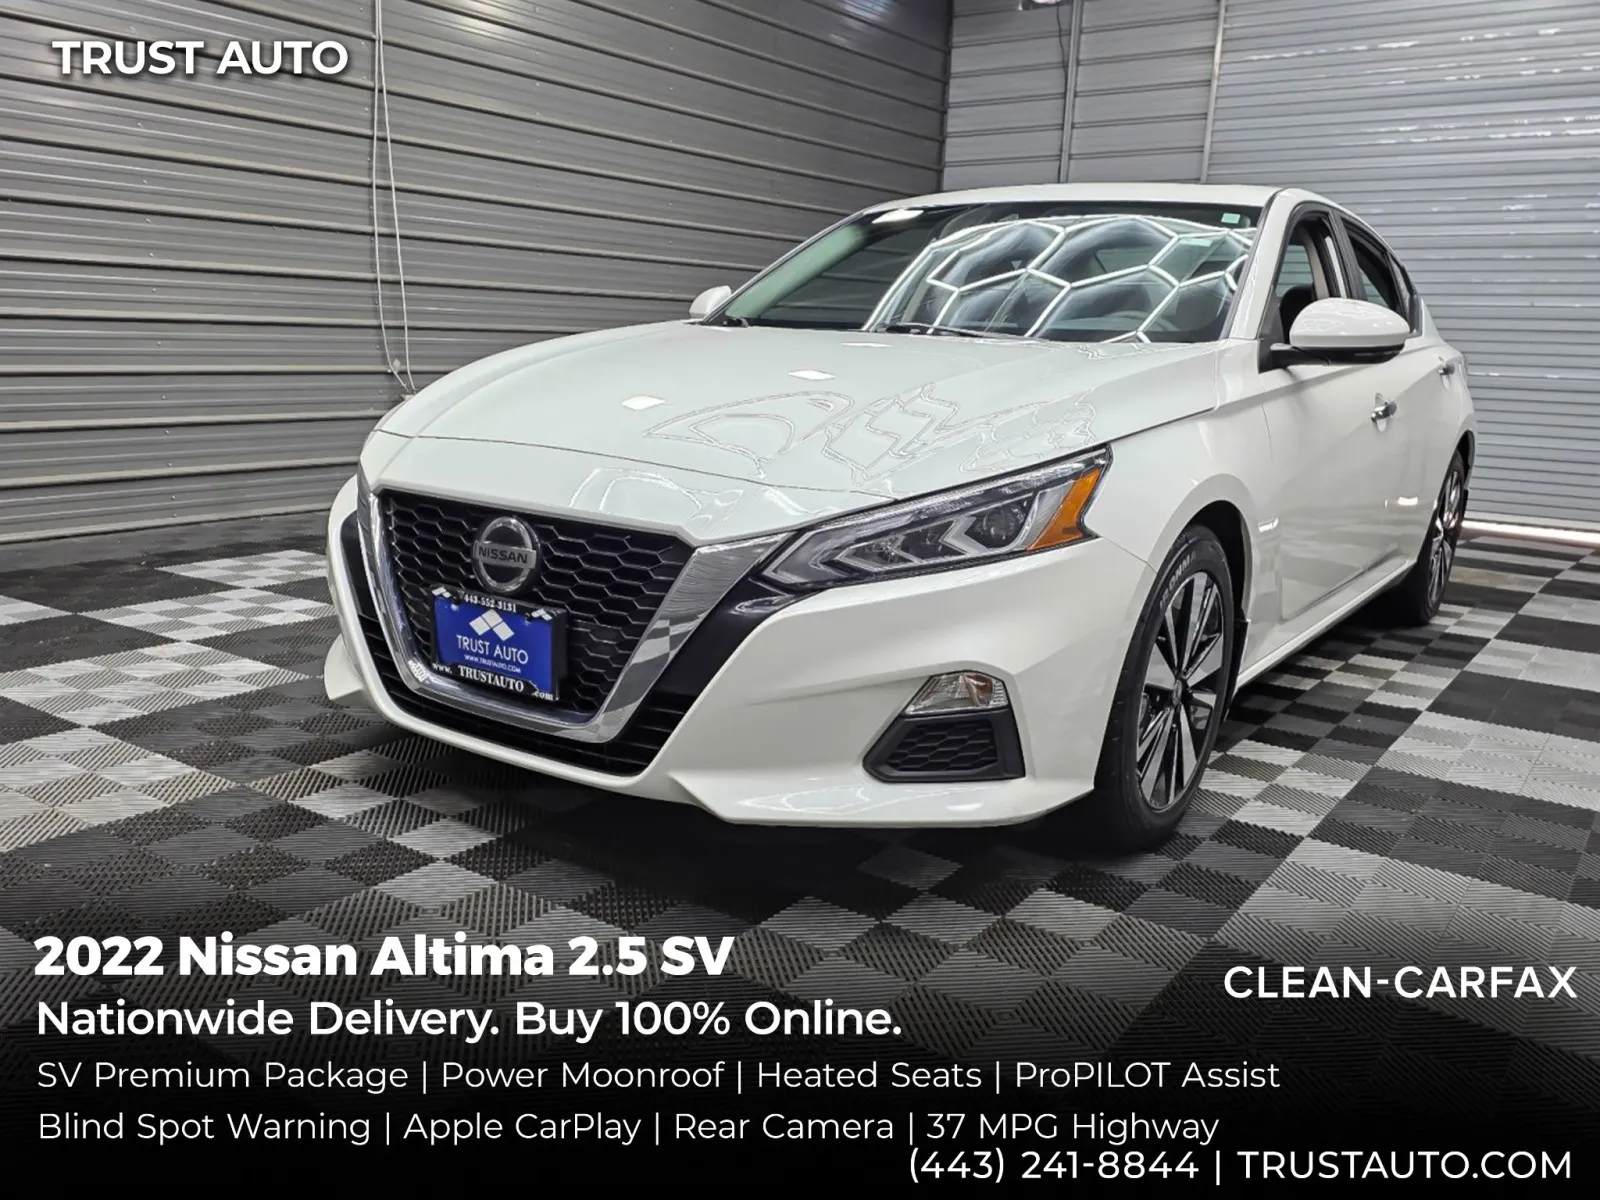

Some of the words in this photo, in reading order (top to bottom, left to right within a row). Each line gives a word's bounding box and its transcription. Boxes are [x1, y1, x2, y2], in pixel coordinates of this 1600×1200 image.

[478, 546, 528, 564] NISSAN
[456, 634, 491, 656] TRUST
[493, 644, 529, 665] AUTO
[458, 665, 525, 692] TRUSTAUTO
